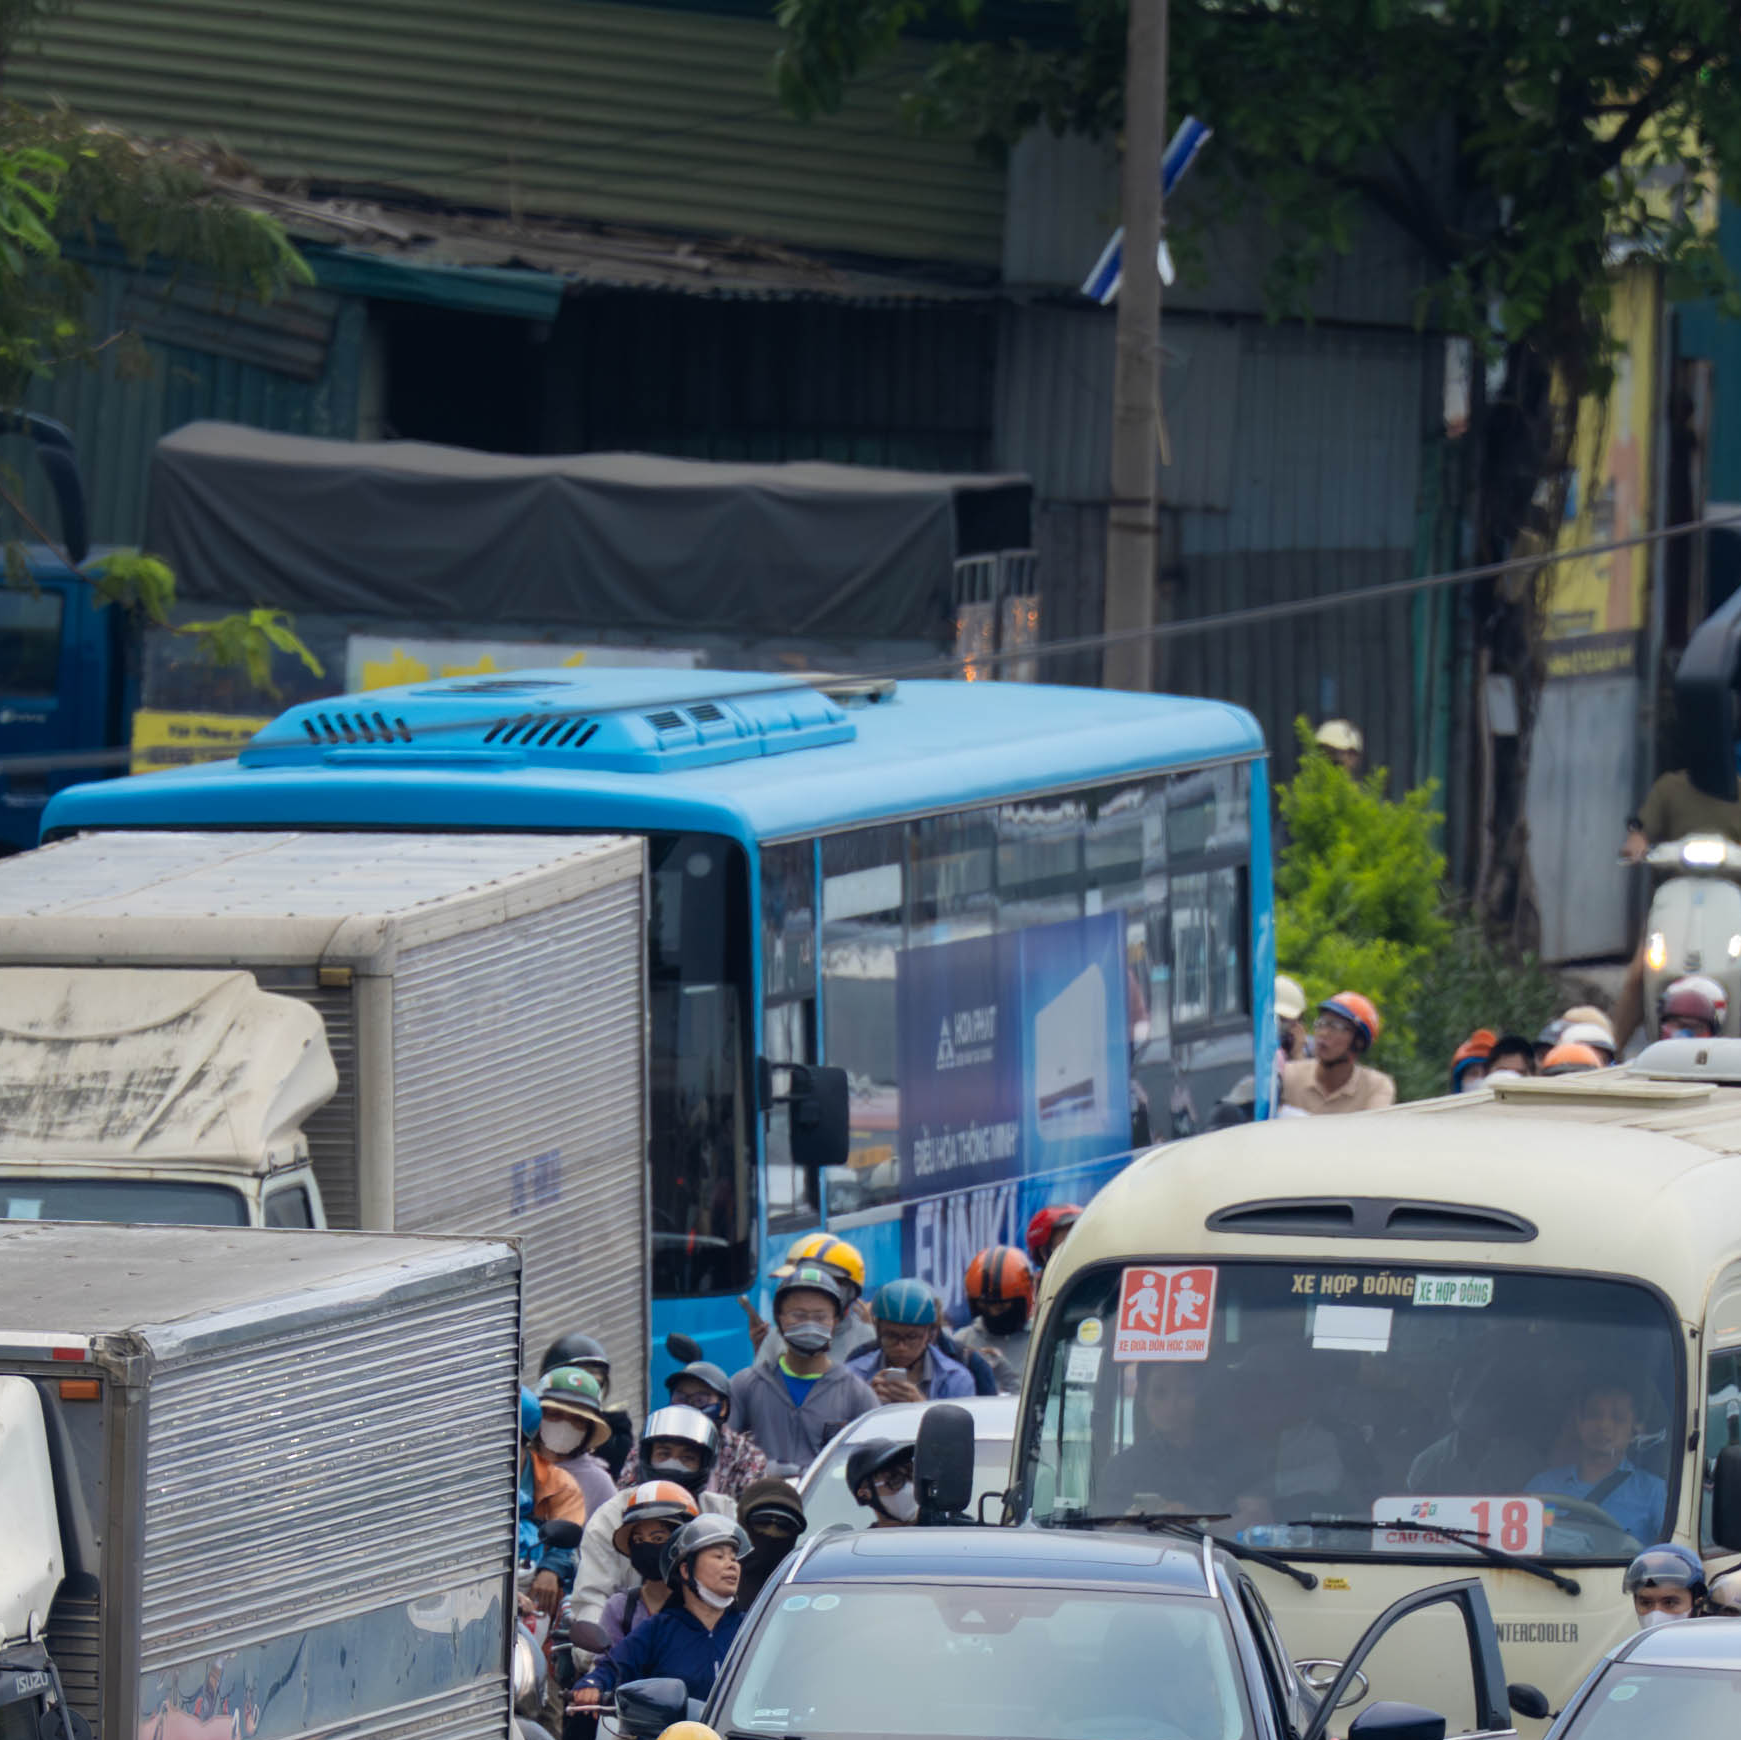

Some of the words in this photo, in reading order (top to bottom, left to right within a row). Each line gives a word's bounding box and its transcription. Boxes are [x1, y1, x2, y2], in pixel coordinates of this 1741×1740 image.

[1292, 1274, 1317, 1294] XE
[1320, 1275, 1357, 1298] HỢP
[1363, 1271, 1415, 1296] ĐỒNG
[1419, 1281, 1432, 1302] XE
[1434, 1281, 1457, 1306] HỢP
[1119, 1339, 1129, 1352] XE
[1470, 1500, 1529, 1552] 18
[1494, 1622, 1579, 1643] NTERCOOLER
[16, 1671, 49, 1694] ISUZU
